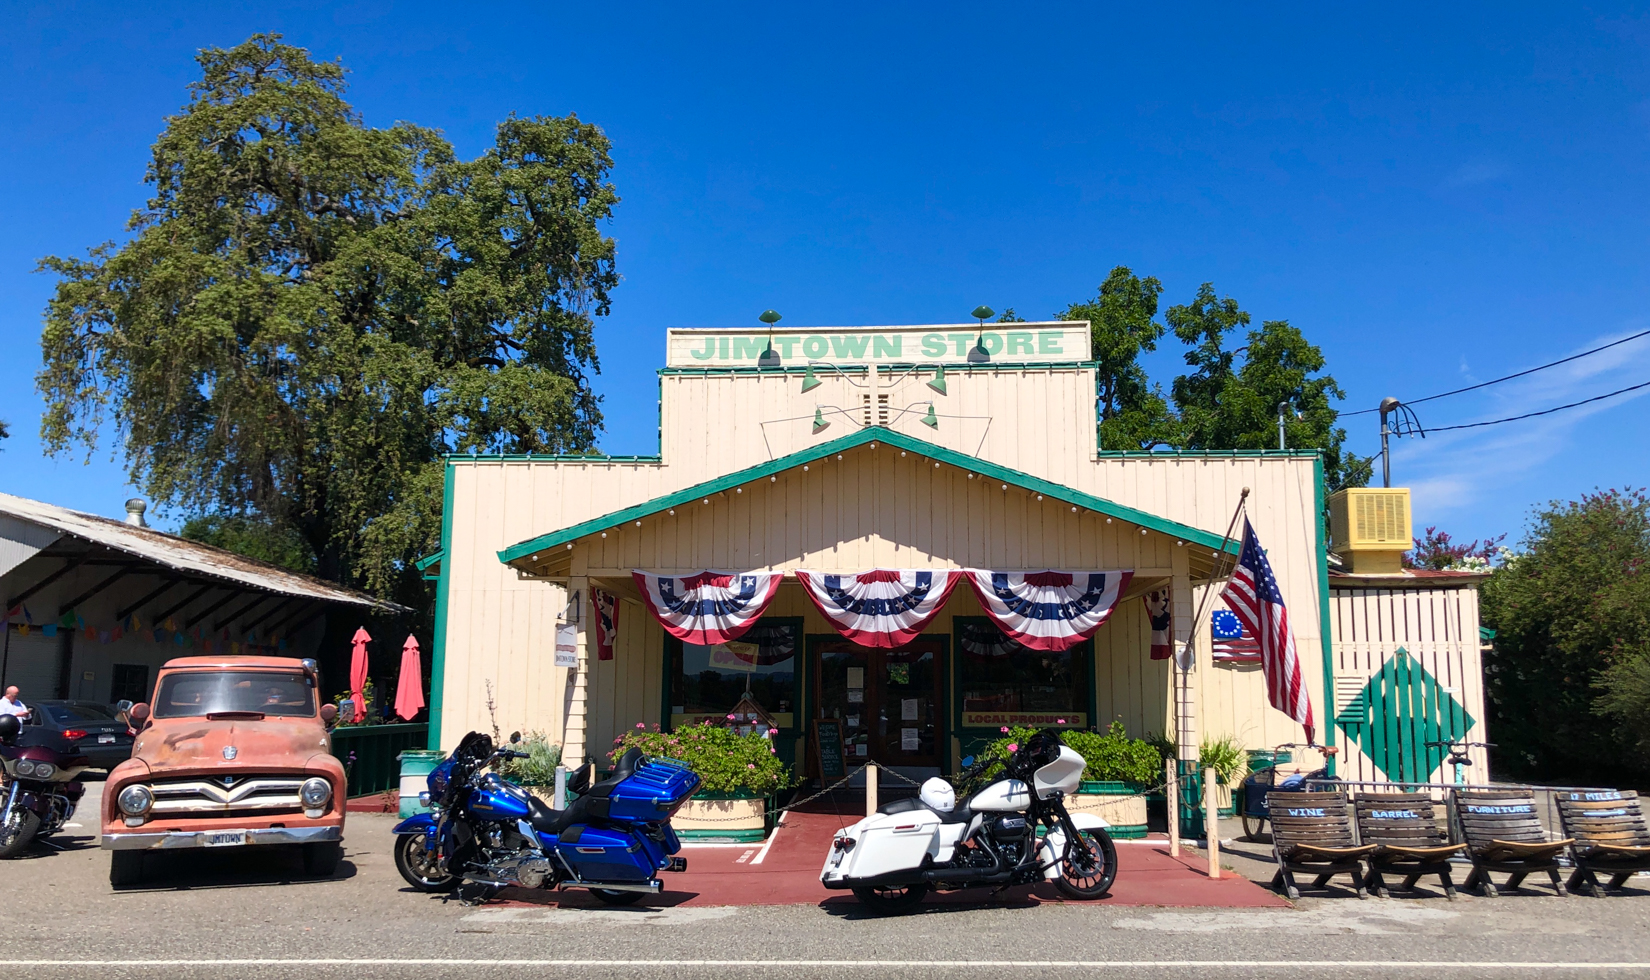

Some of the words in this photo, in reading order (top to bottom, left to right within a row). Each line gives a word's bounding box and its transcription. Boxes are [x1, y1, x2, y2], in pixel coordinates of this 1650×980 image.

[690, 335, 903, 361] JIMTOWN
[920, 330, 1064, 358] STORE
[968, 714, 1007, 724] LOCAL
[1009, 714, 1080, 724] PRODUCTS
[1585, 792, 1621, 800] MILES
[1288, 808, 1325, 817] WINE
[1371, 810, 1418, 818] BARREL
[1467, 805, 1531, 814] FURNITURE
